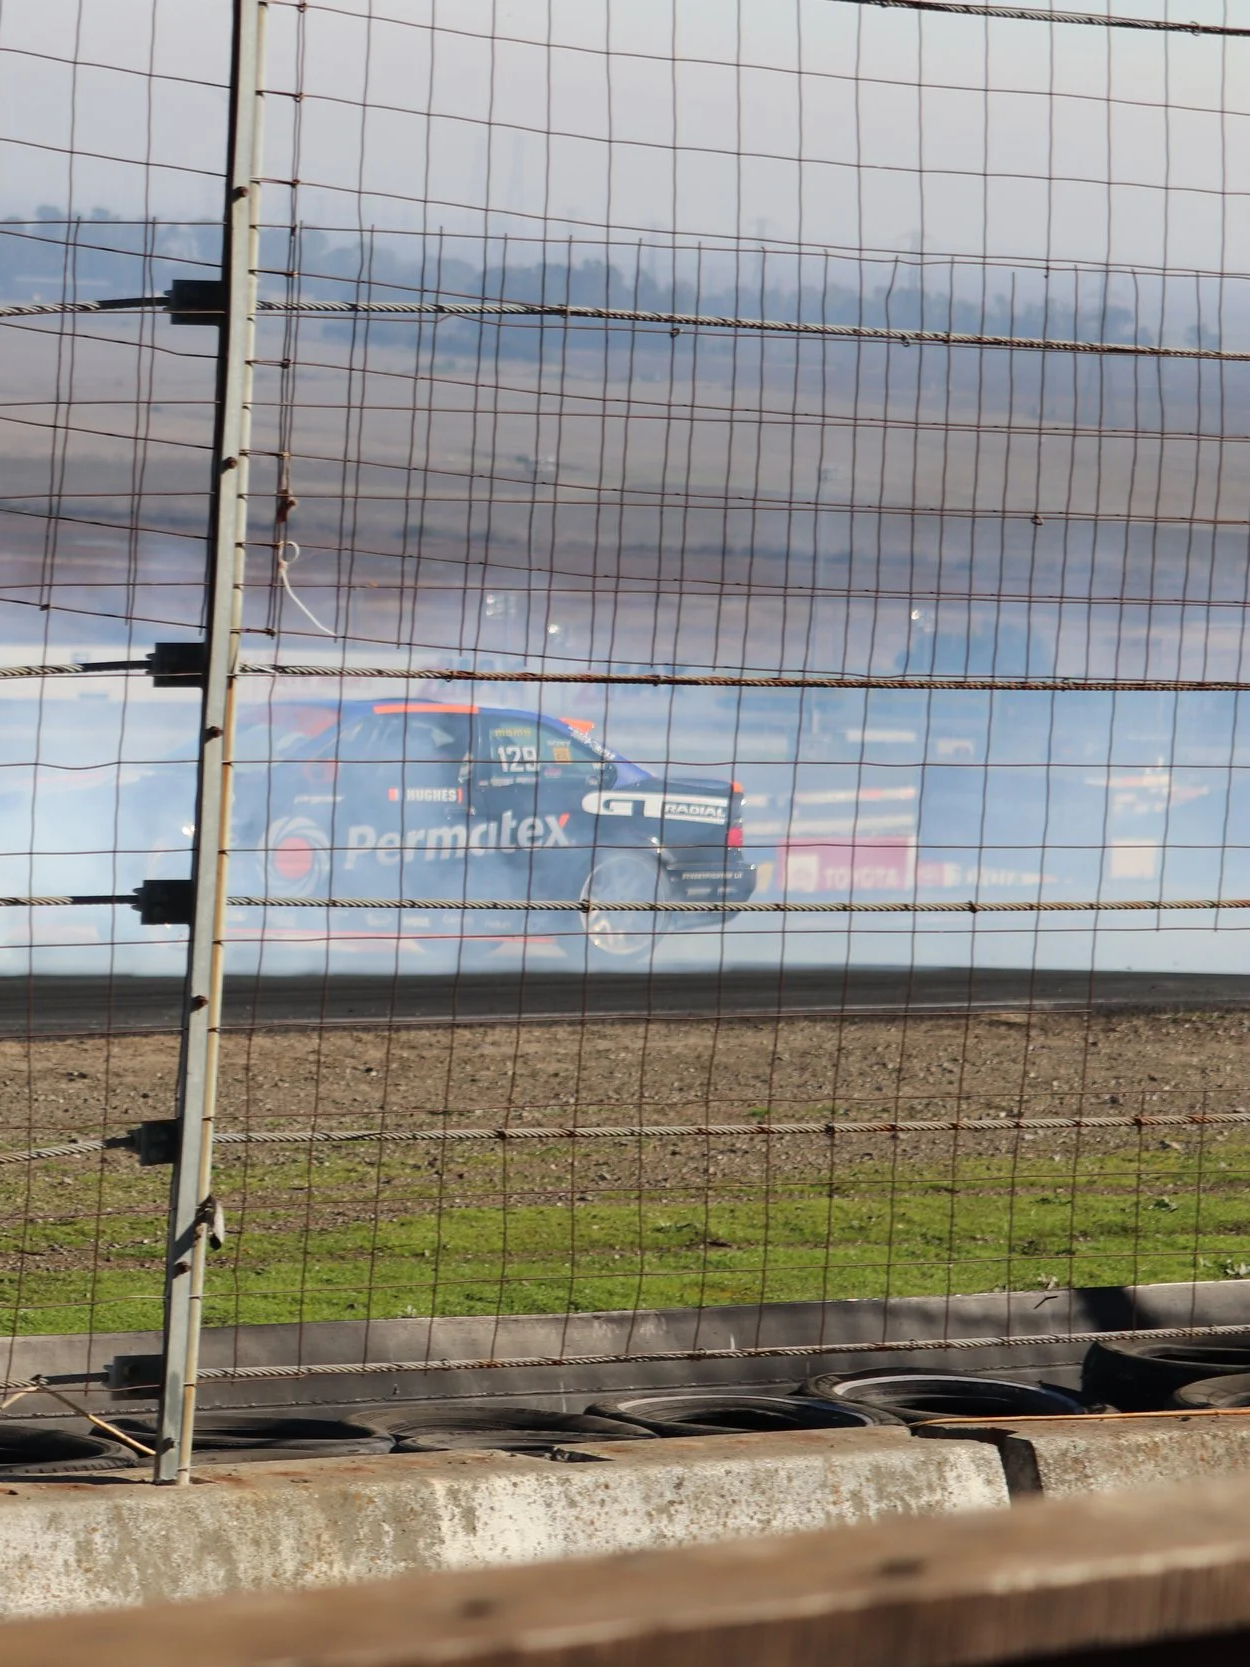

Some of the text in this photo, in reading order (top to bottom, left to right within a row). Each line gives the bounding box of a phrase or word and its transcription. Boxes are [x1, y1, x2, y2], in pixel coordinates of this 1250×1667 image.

[497, 745, 541, 773] 129
[406, 788, 458, 803] HUGHES
[664, 802, 727, 818] RADIAL
[344, 810, 572, 870] Permatex
